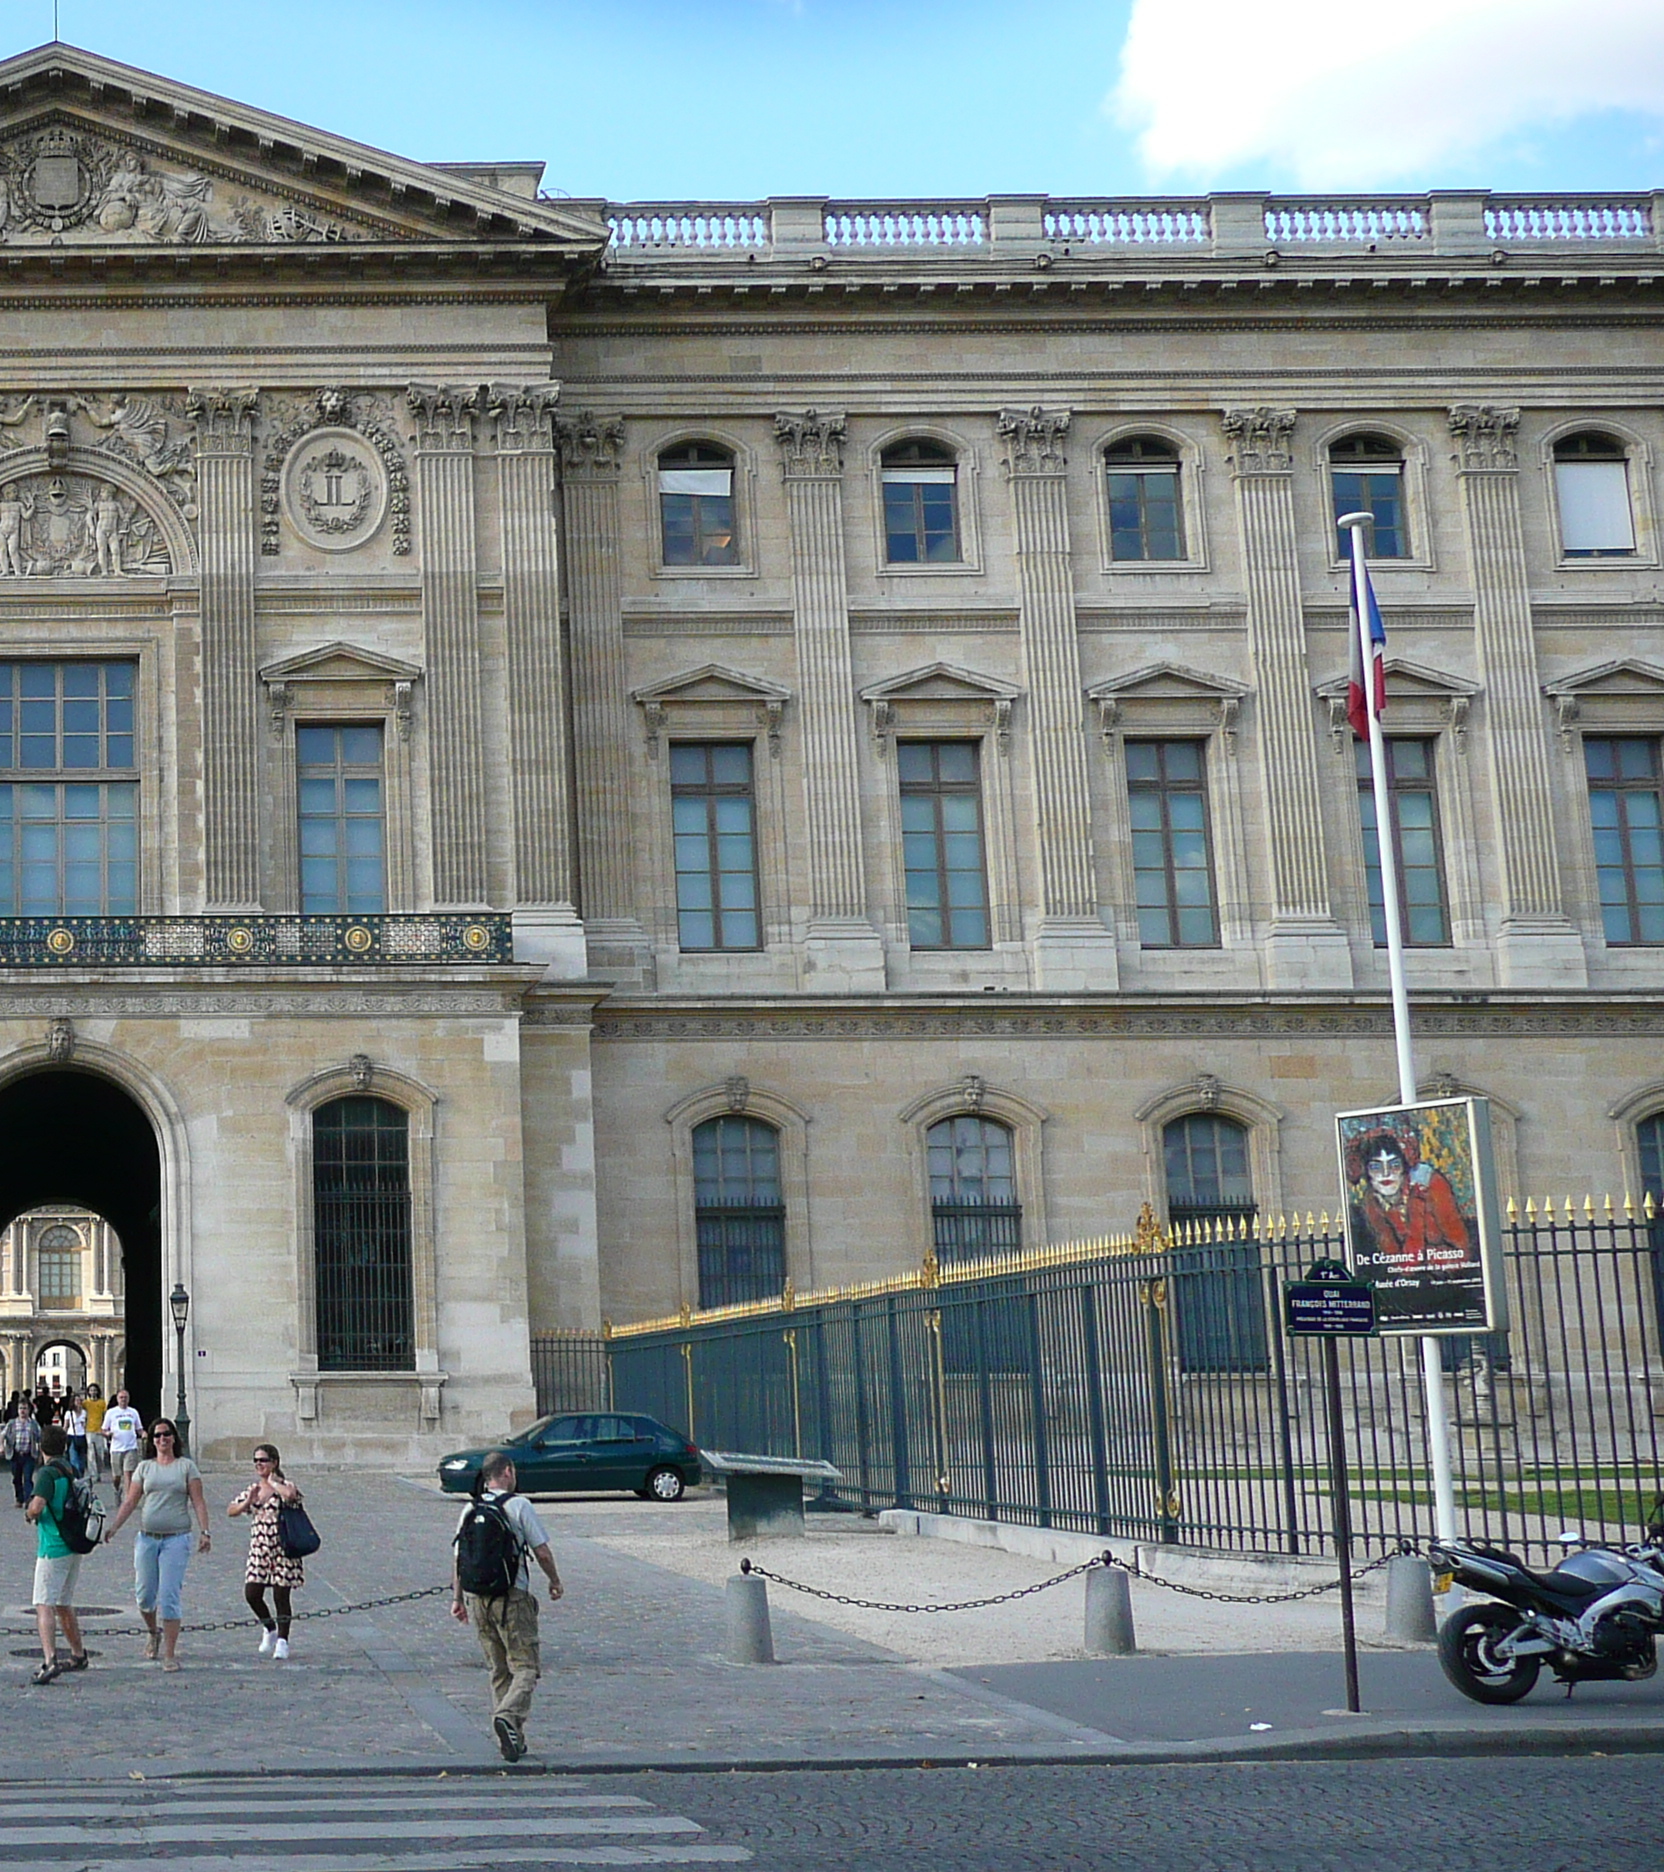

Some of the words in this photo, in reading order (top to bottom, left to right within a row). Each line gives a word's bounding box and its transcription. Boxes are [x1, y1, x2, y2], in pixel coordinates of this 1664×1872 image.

[1356, 1253, 1371, 1266] De
[1372, 1251, 1415, 1264] Cézanne
[1417, 1249, 1424, 1261] à
[1426, 1247, 1464, 1260] Picasso
